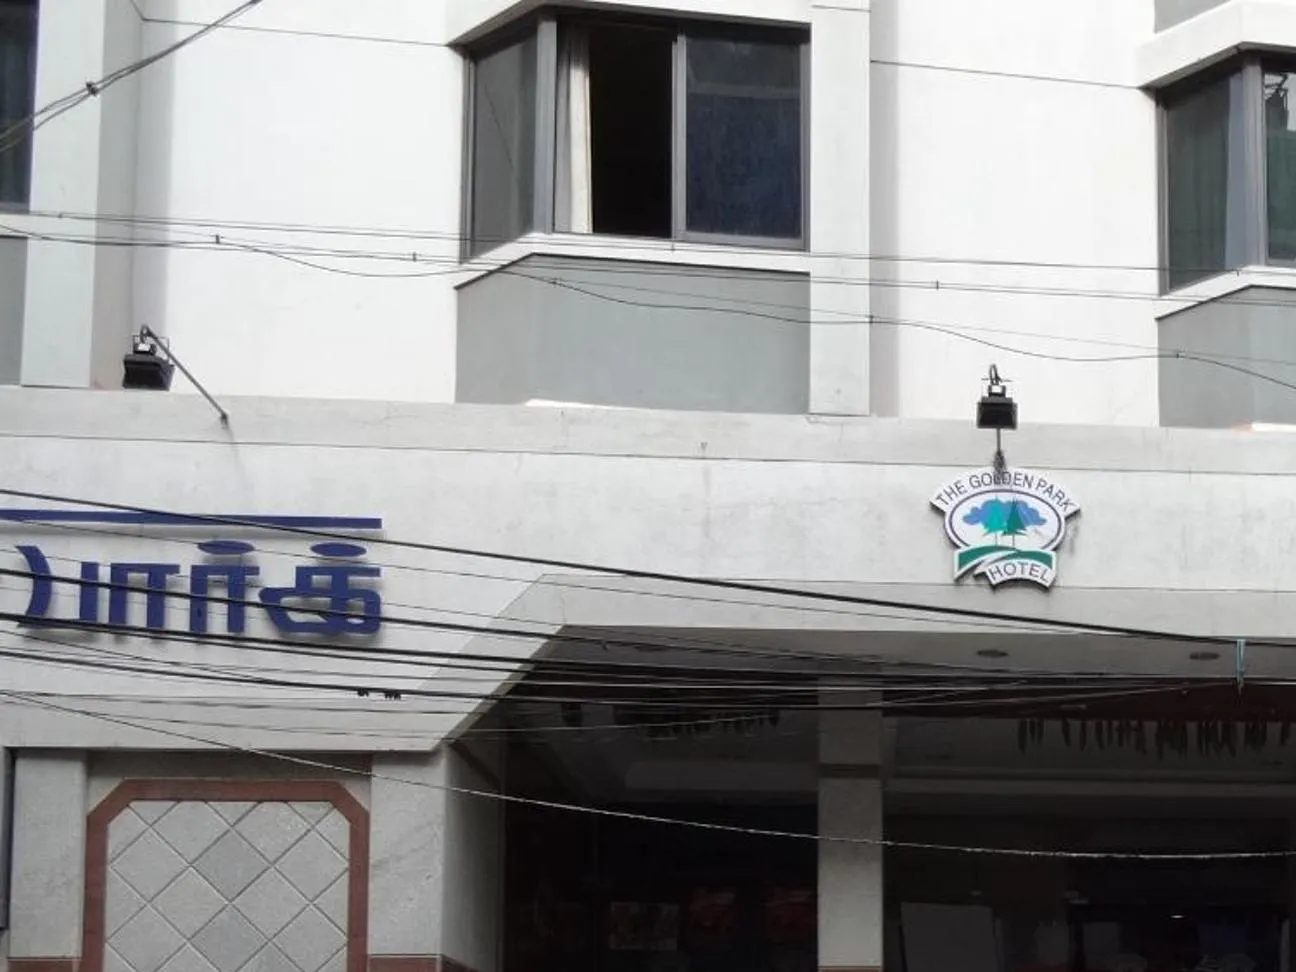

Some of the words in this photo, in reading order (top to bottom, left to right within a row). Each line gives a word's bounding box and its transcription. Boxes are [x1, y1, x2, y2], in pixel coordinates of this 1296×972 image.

[935, 480, 970, 506] THE
[969, 470, 1034, 490] GOLDEN
[1035, 477, 1075, 512] PARK
[988, 561, 1051, 583] HOTEL
